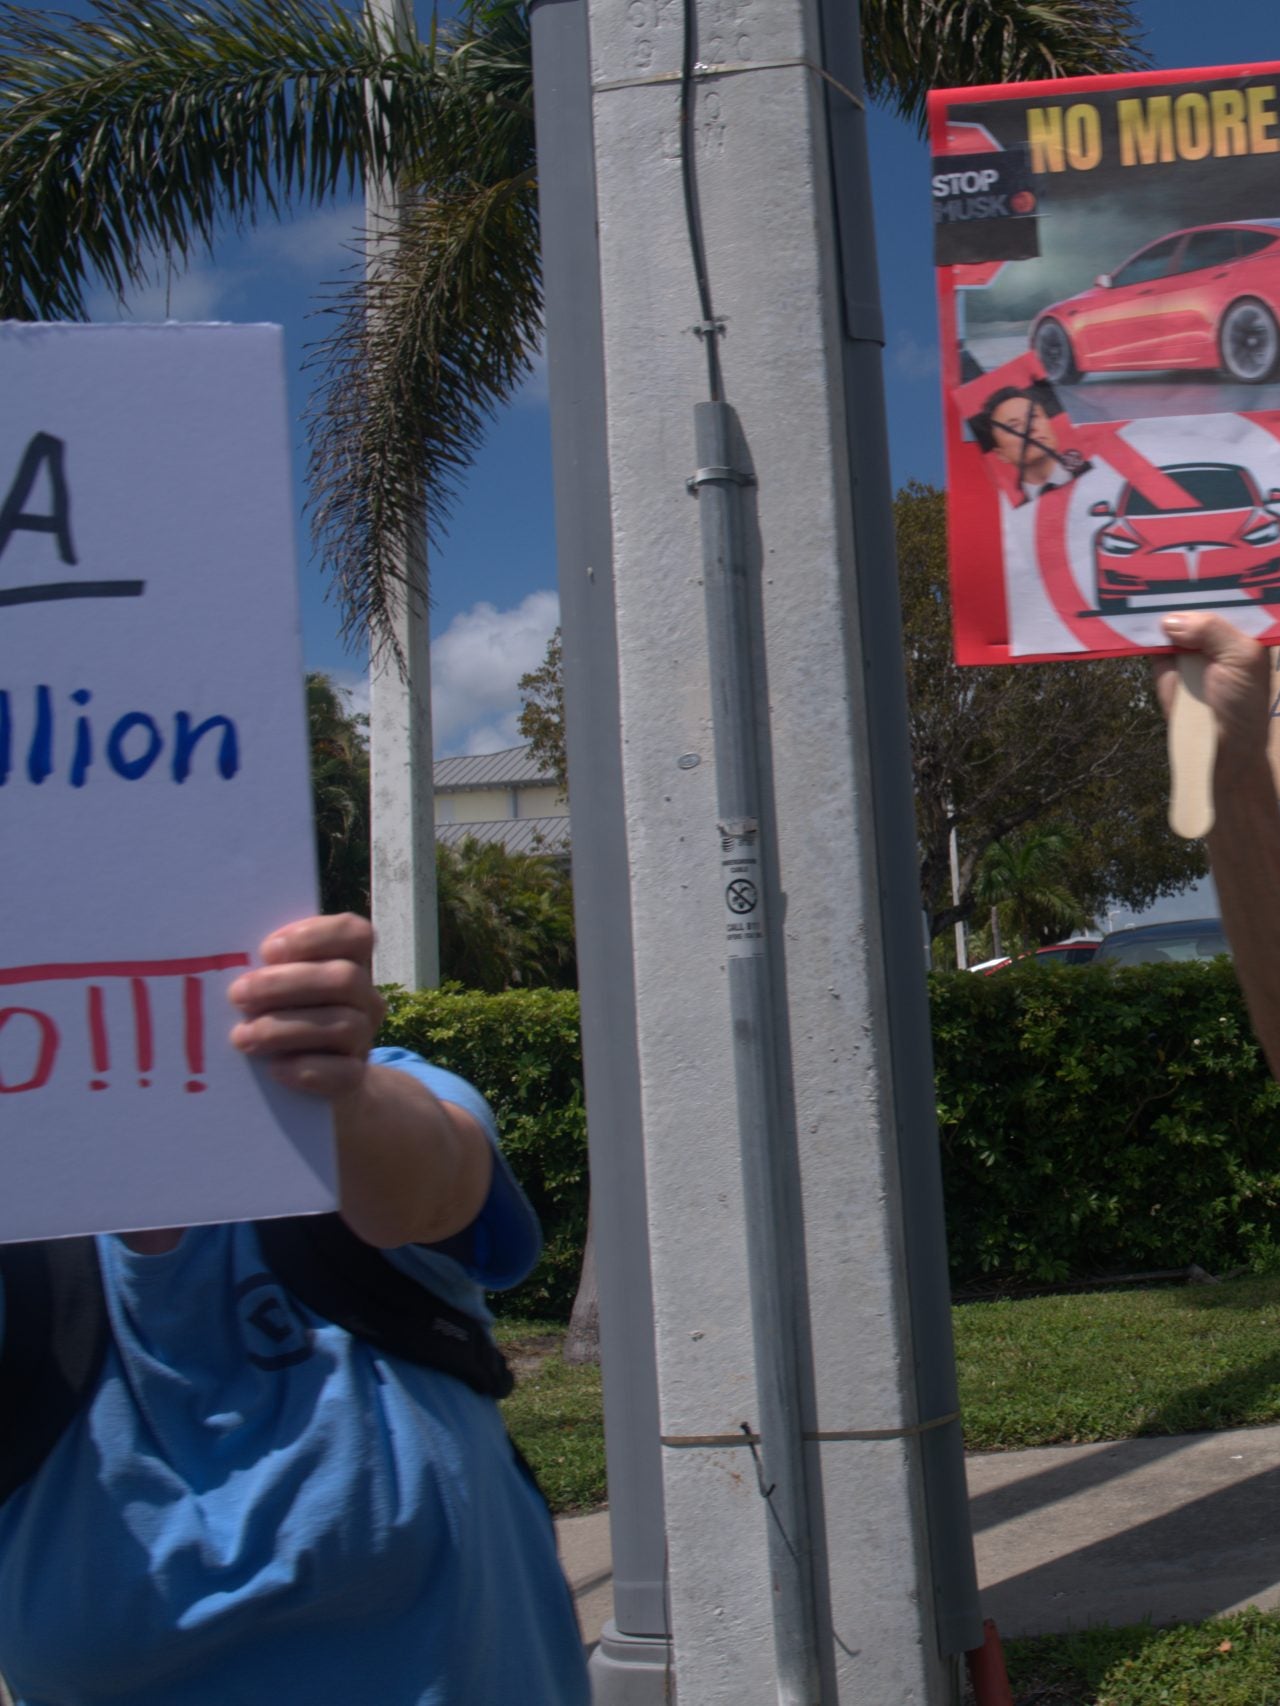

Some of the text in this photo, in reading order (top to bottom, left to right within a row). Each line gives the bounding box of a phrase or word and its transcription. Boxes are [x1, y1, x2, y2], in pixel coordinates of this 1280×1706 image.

[1027, 102, 1101, 175] NO
[932, 169, 999, 198] STOP
[934, 192, 1010, 224] MUSK
[0, 430, 79, 566] A
